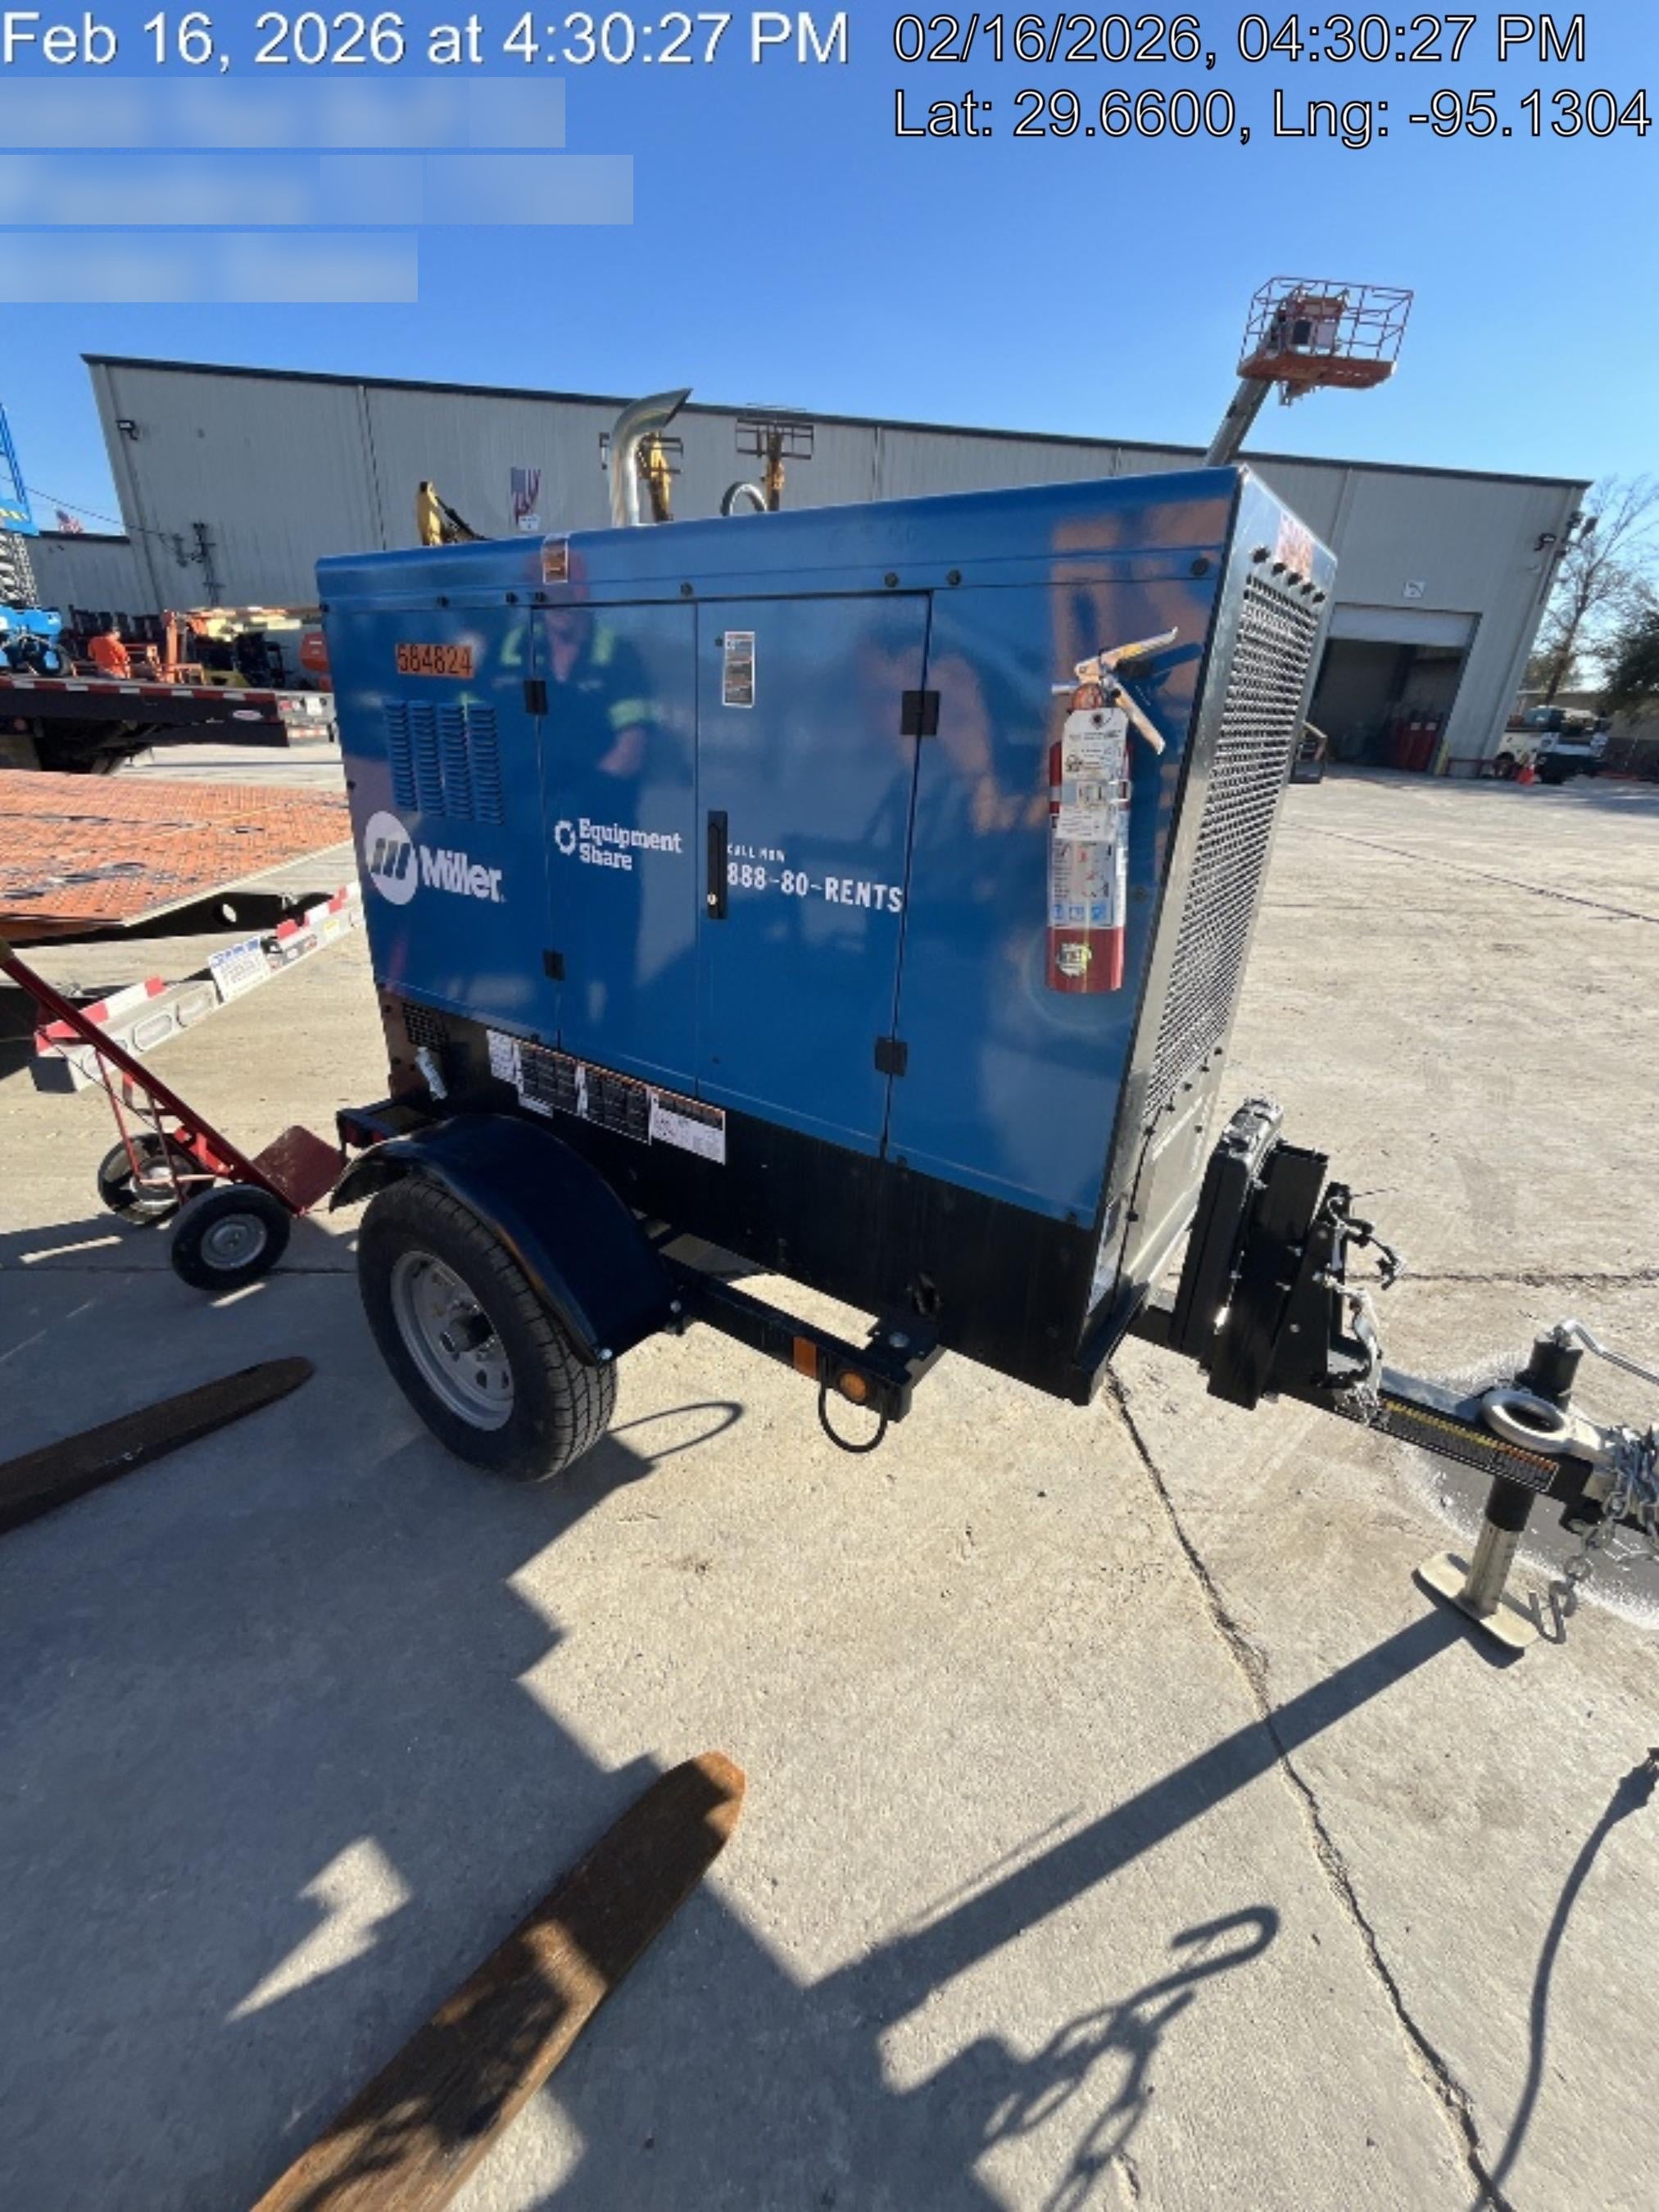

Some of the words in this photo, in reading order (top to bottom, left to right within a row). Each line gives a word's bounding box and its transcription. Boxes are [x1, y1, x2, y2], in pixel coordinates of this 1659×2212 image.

[578, 817, 682, 854] Equipment
[419, 845, 503, 903] Miller
[578, 842, 633, 871] Share
